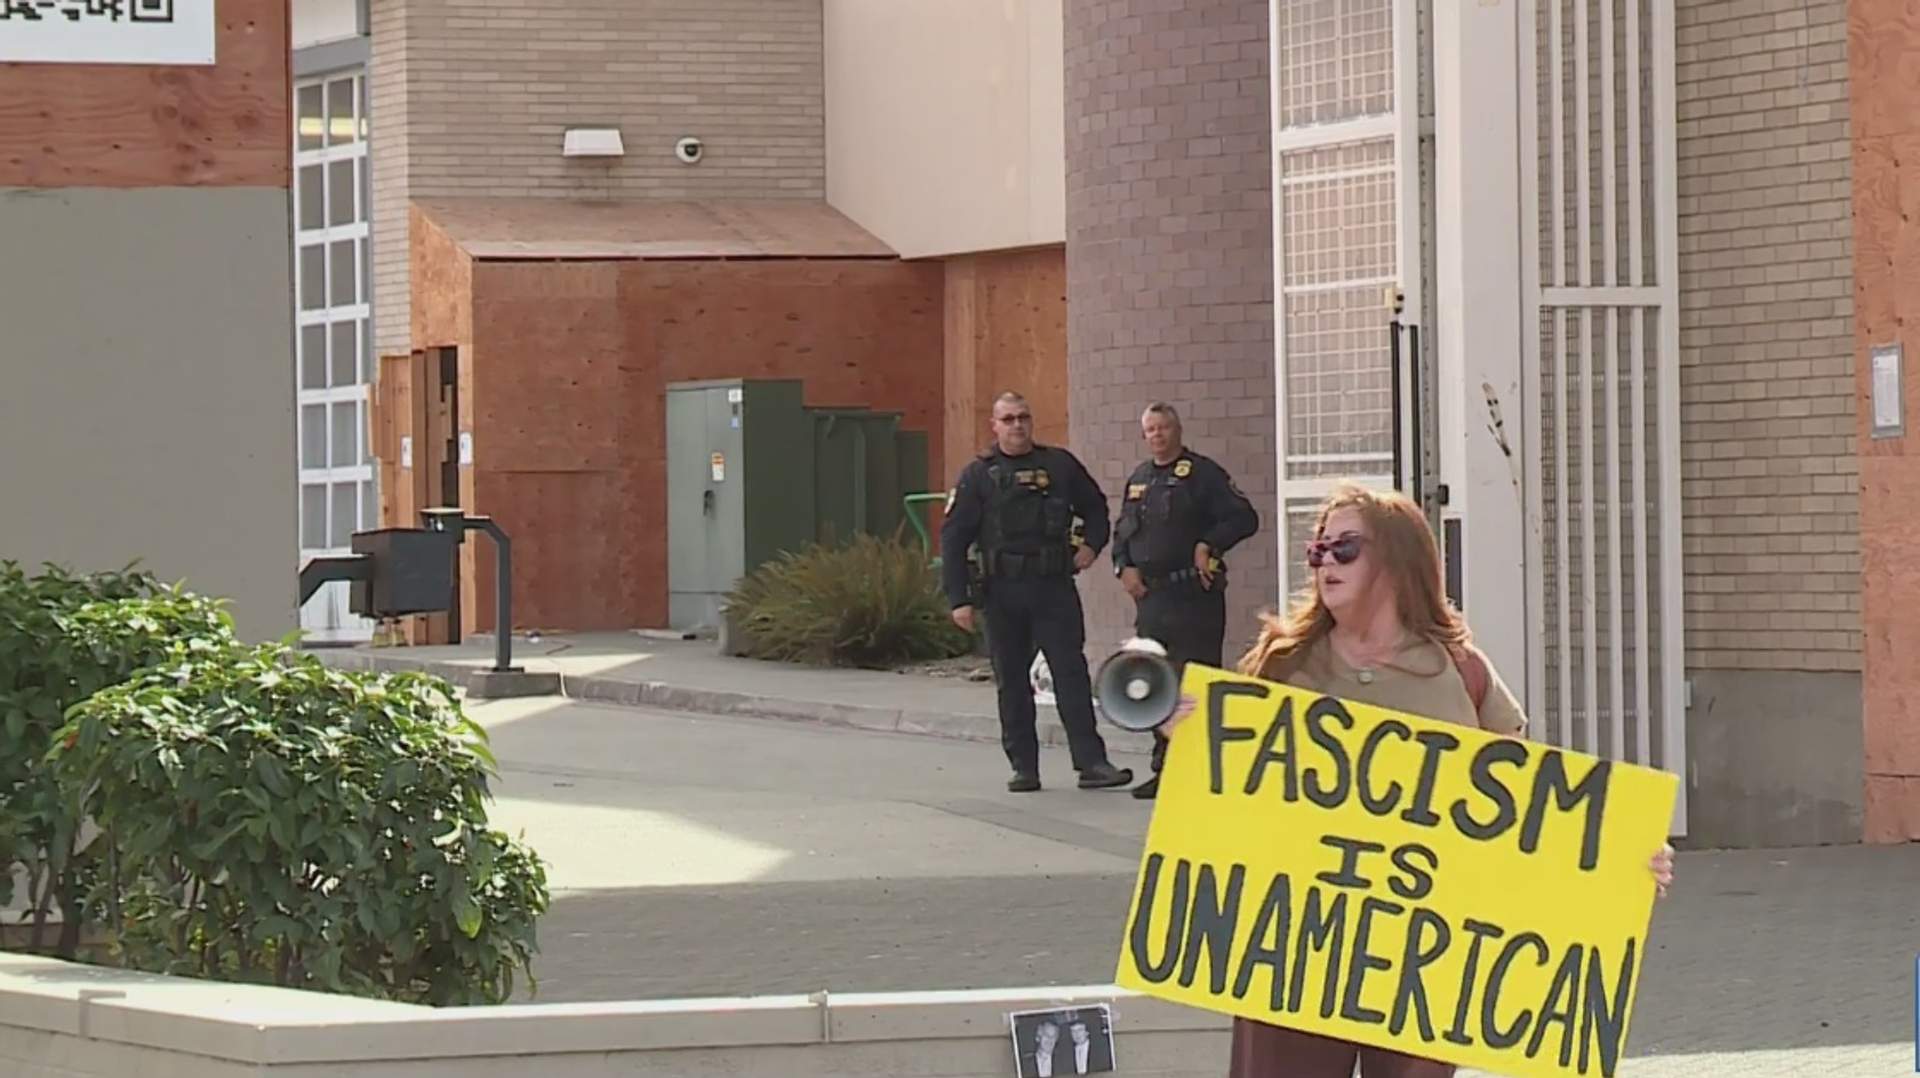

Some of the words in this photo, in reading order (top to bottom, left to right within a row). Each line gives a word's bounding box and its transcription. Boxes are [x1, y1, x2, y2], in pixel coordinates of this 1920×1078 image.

[1207, 681, 1612, 871] FASCISM
[1316, 835, 1438, 900] IS
[1130, 853, 1635, 1077] UNAMERICAN
